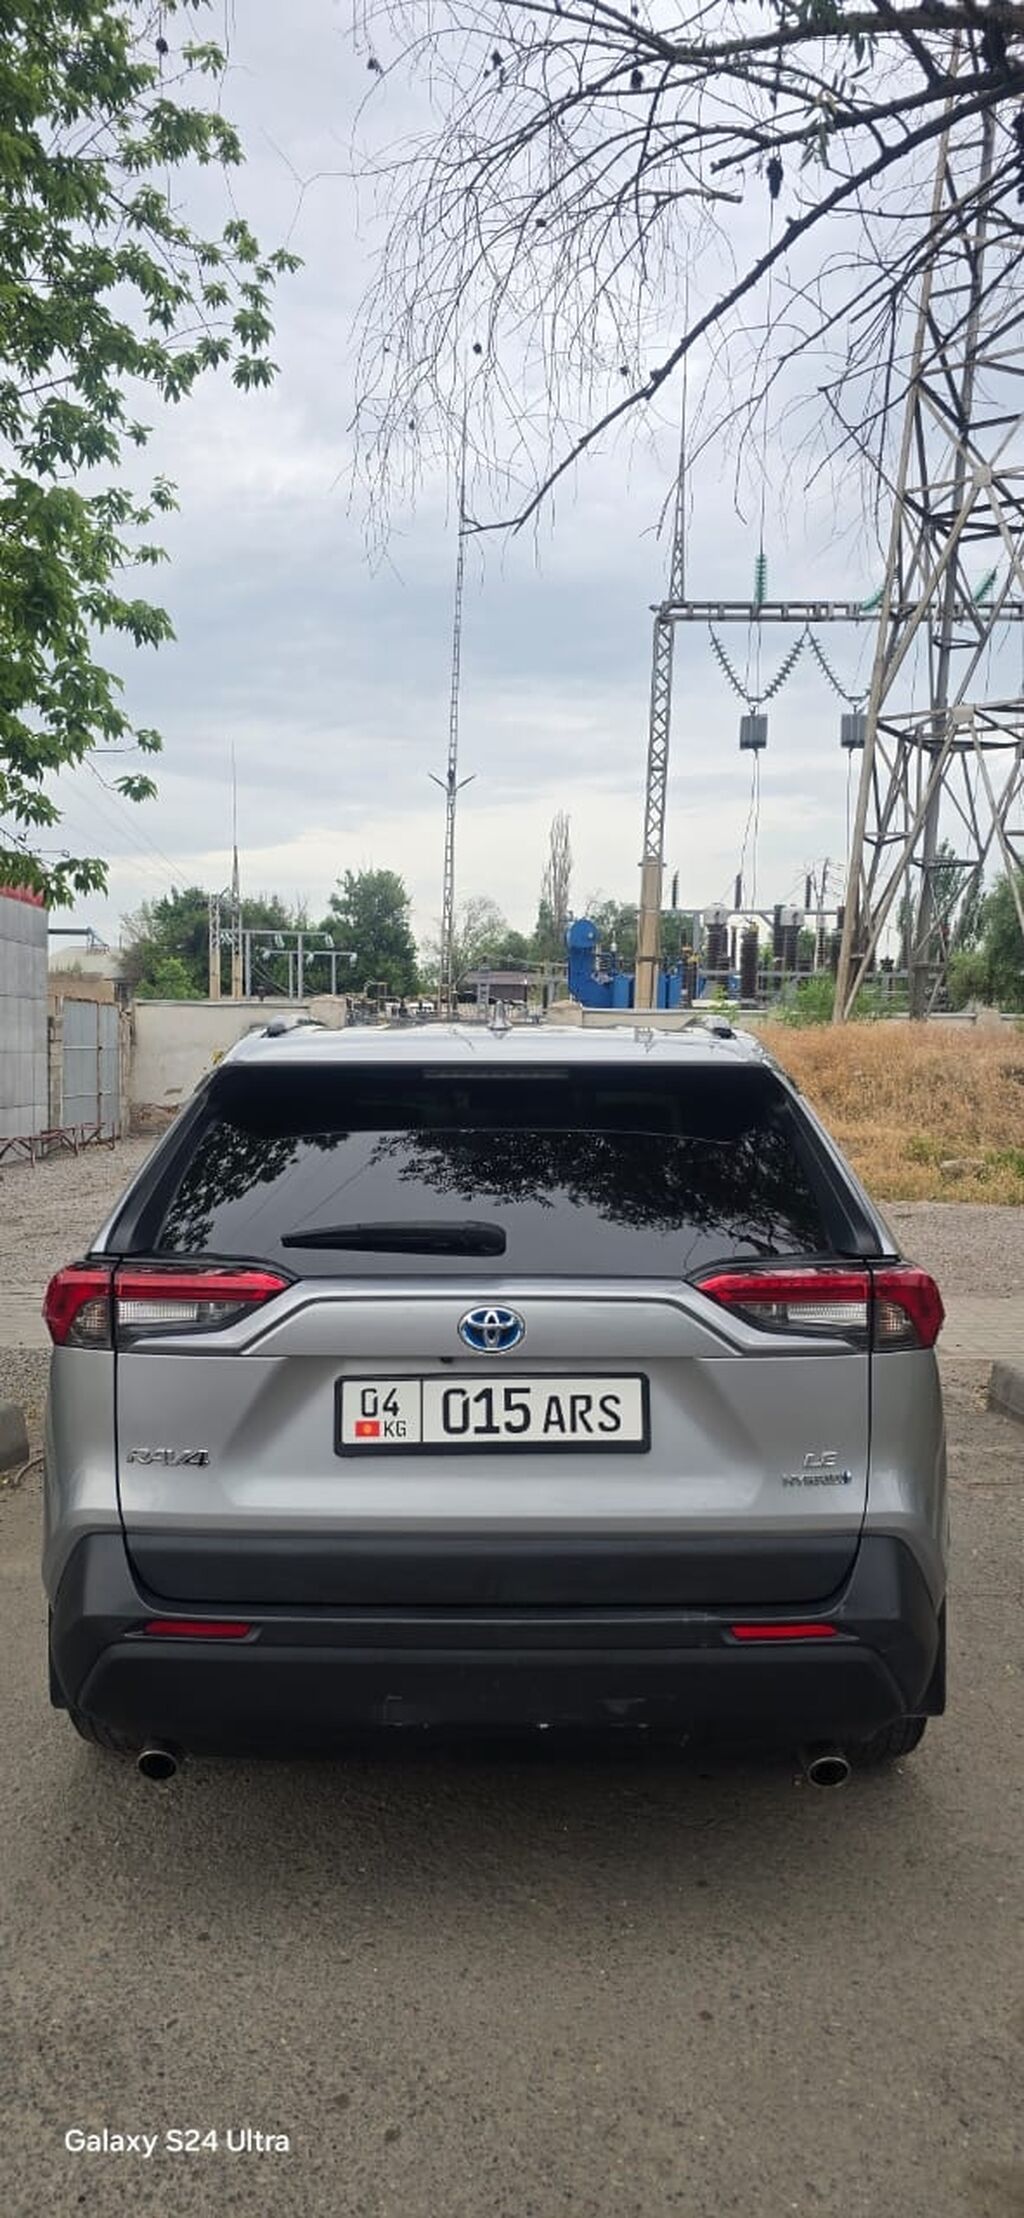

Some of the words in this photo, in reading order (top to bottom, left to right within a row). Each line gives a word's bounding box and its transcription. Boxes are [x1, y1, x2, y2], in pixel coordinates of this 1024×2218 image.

[361, 1387, 400, 1417] 04
[442, 1387, 531, 1435] 015
[543, 1394, 622, 1434] ARS
[383, 1420, 407, 1438] KG
[126, 1448, 210, 1467] RAV4
